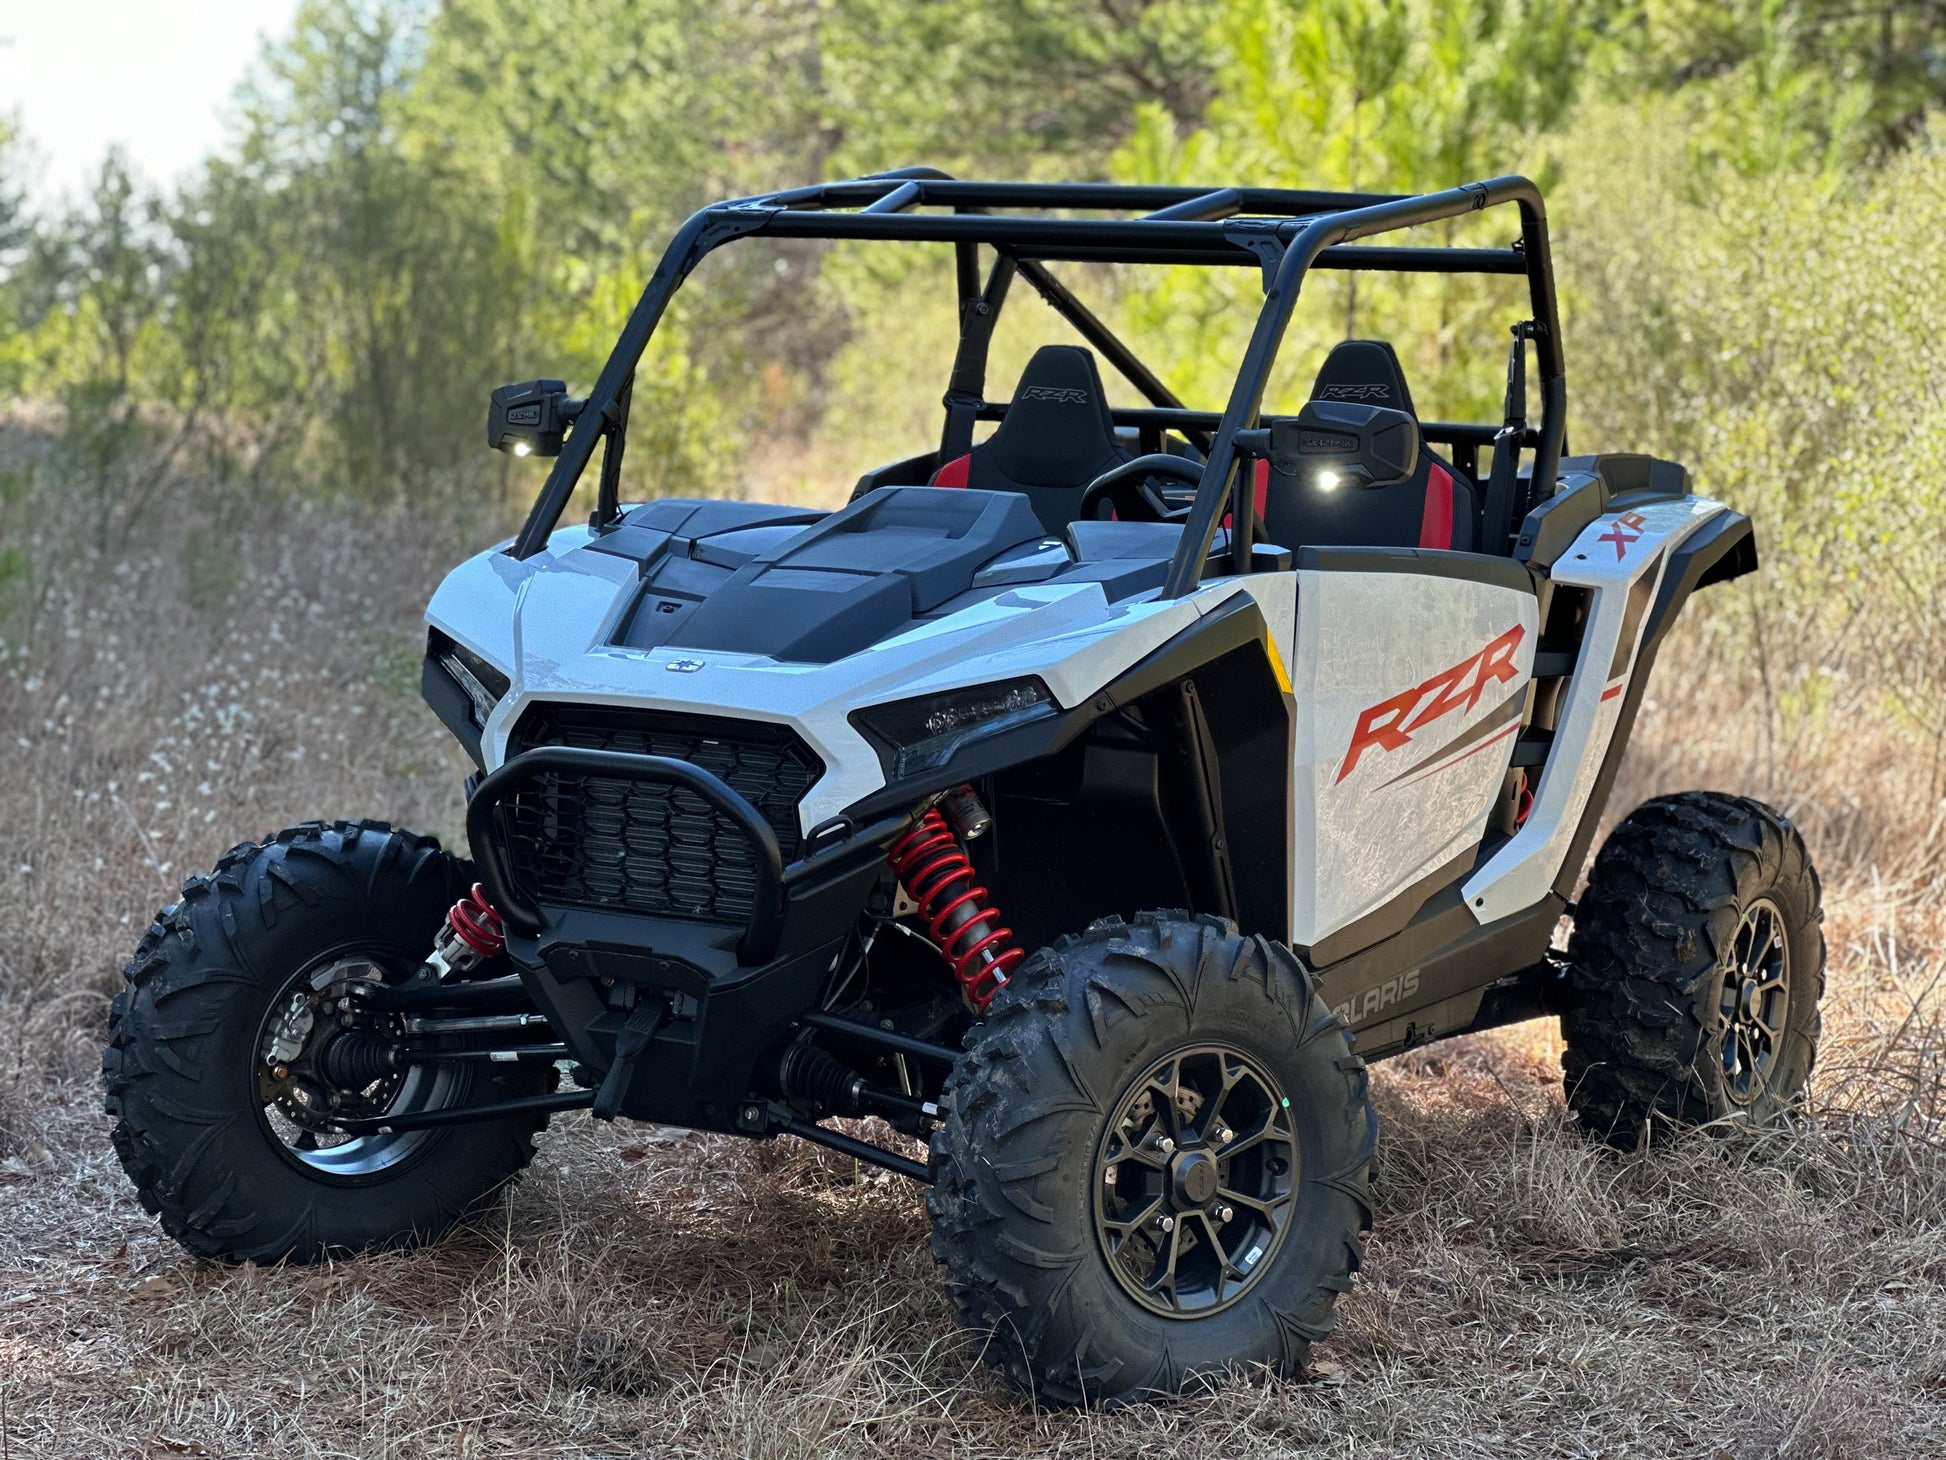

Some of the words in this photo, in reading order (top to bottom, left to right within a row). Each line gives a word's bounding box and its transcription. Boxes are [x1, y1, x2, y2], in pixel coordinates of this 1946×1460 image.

[1021, 385, 1088, 404] RZR
[1318, 384, 1390, 400] RZR
[1305, 437, 1355, 449] SEIZMIK
[1597, 511, 1648, 563] XP
[1333, 622, 1526, 788] RZR
[1332, 967, 1421, 1024] OLARIS
